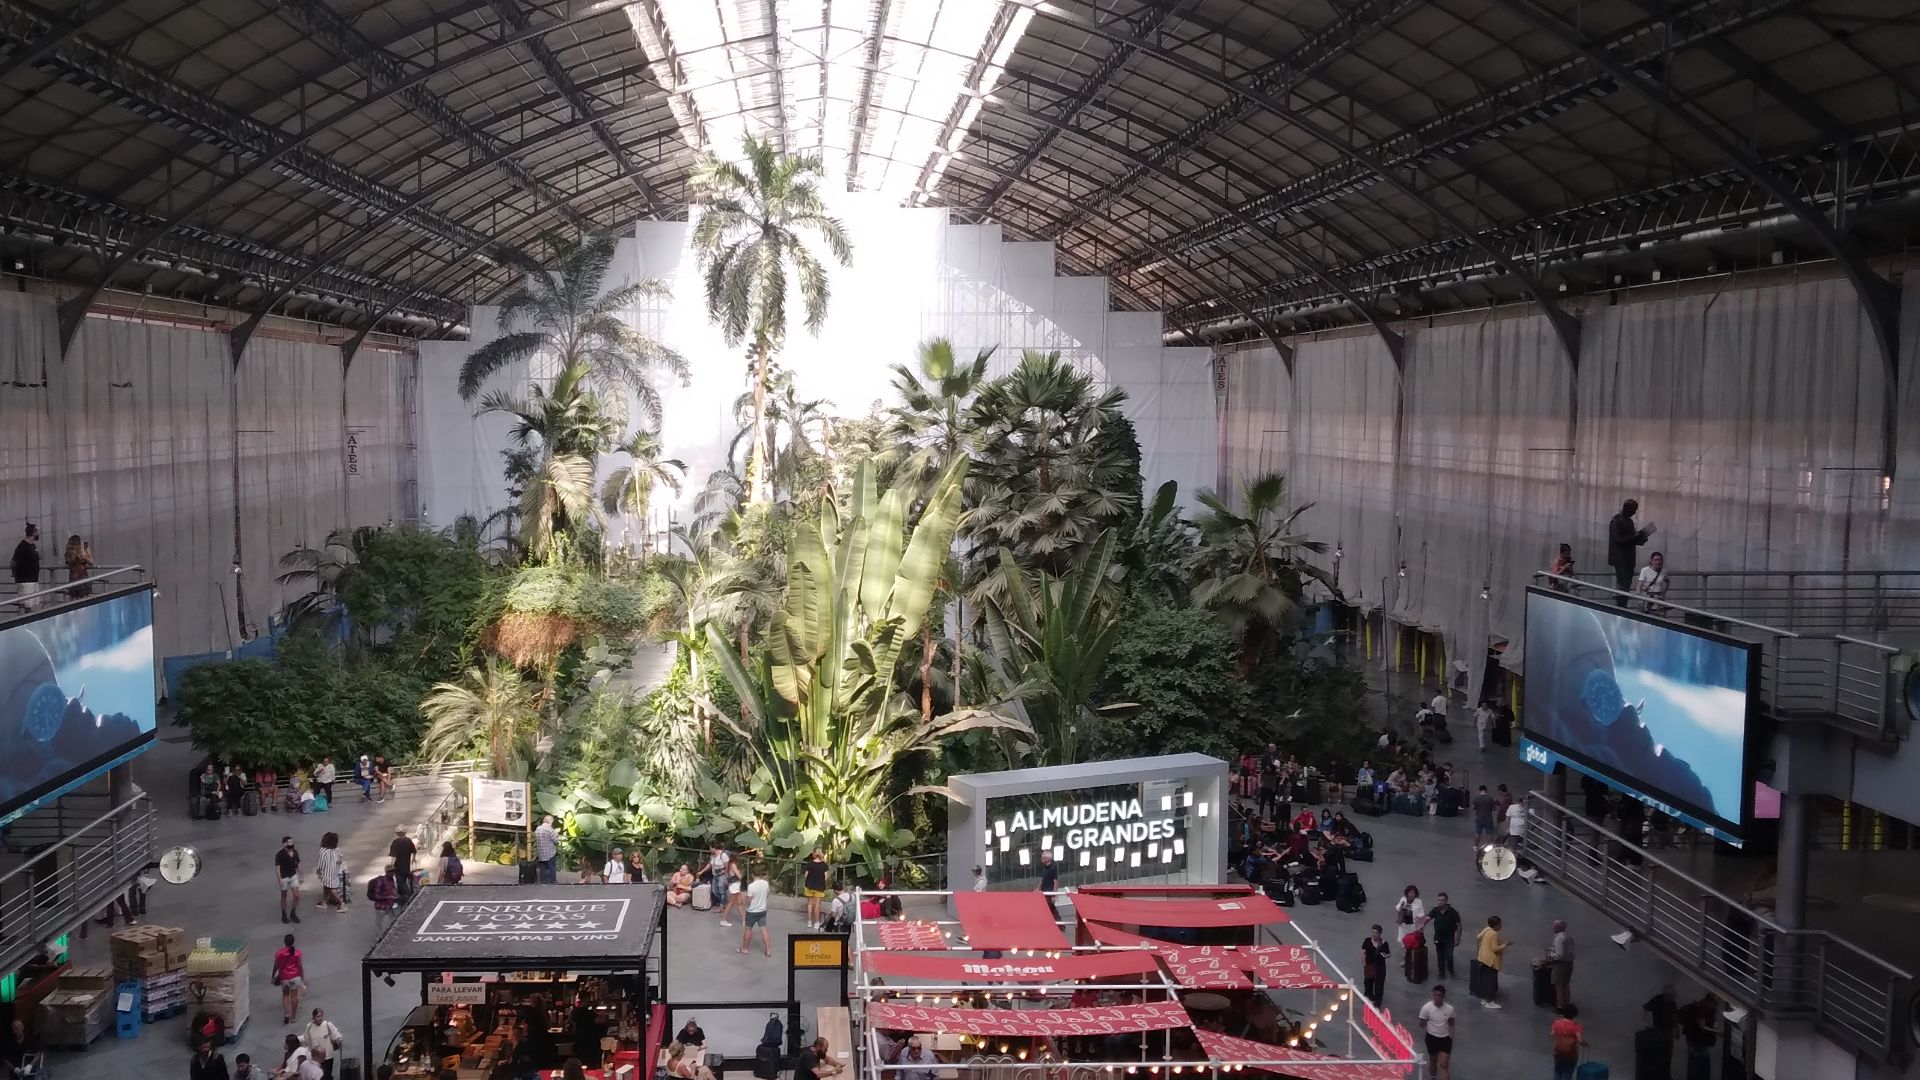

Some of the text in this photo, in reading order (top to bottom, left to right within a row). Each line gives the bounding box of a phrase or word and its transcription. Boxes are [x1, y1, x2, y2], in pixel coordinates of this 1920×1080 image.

[1217, 356, 1227, 389] ATES
[347, 435, 358, 473] ATES
[1526, 744, 1547, 765] global
[1010, 798, 1143, 833] ALMUDENA
[1066, 818, 1175, 850] GRANDES
[455, 904, 607, 914] ENRIQUE
[453, 986, 483, 994] LLEVAR
